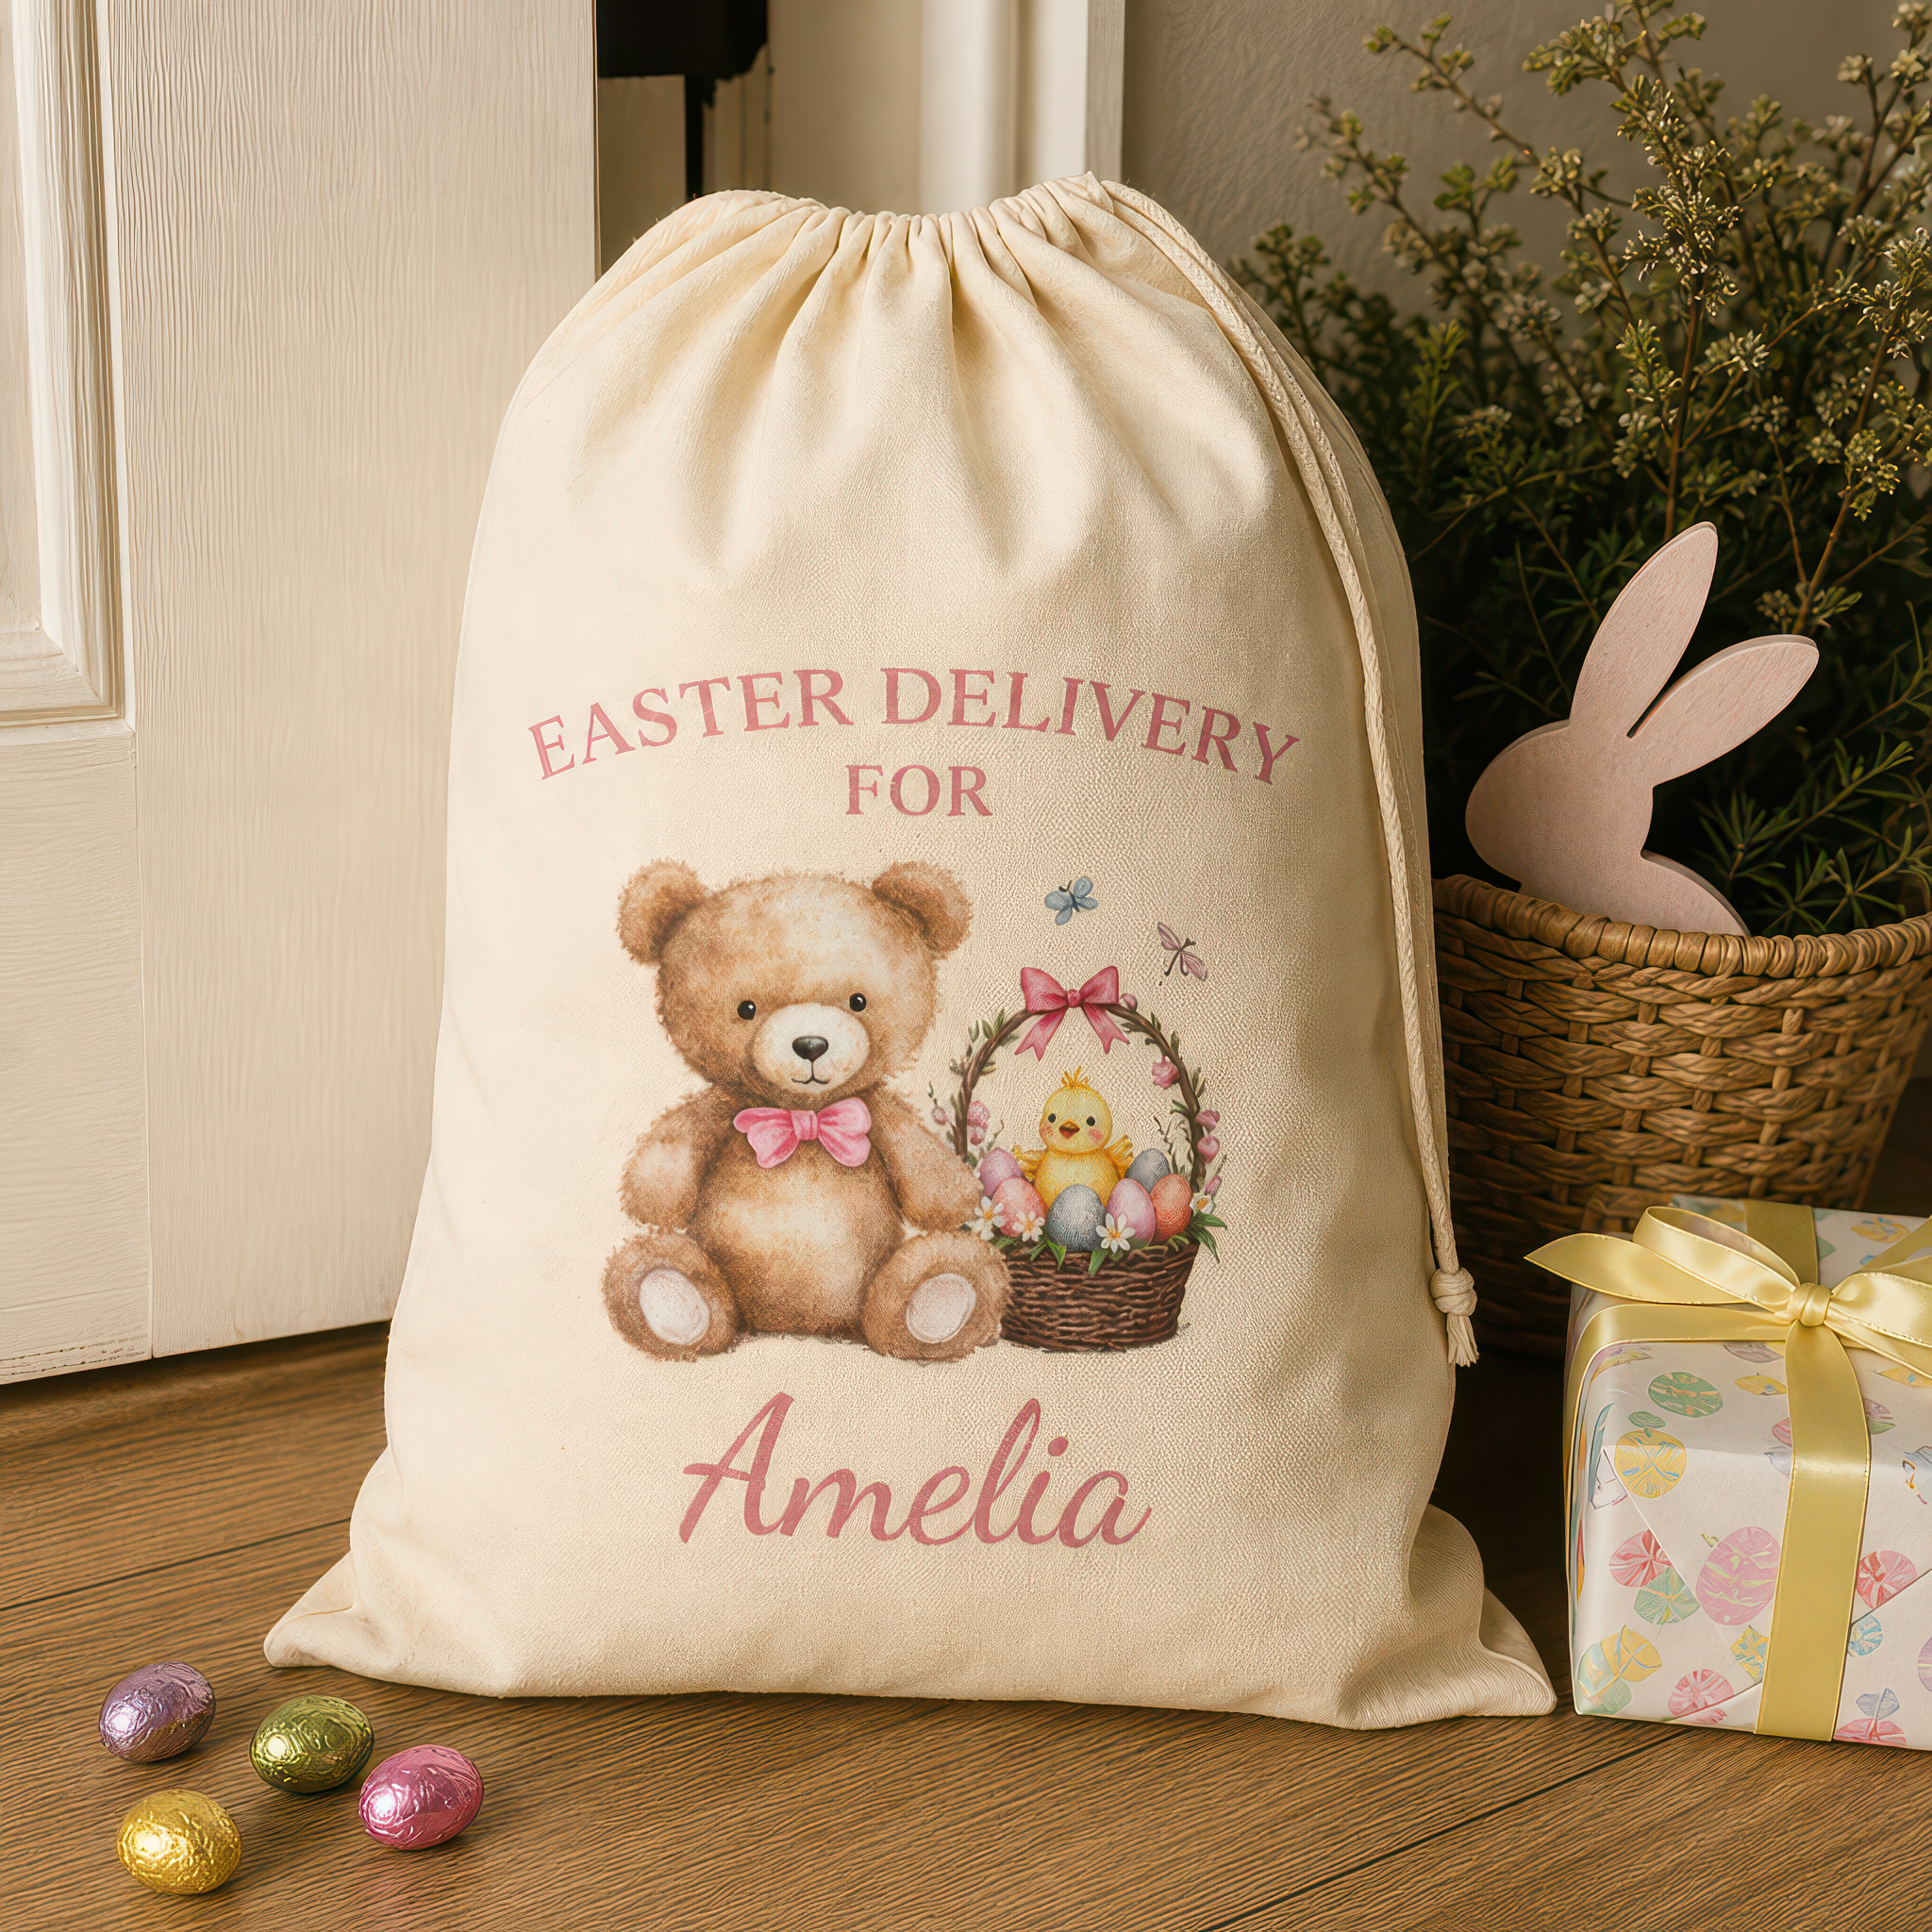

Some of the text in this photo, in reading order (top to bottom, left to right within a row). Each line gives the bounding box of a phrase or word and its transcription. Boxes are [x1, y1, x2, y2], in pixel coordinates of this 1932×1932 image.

[527, 667, 1301, 786] EASTER DELIVERY
[845, 763, 993, 817] FOR
[678, 1391, 1153, 1549] Amelia
